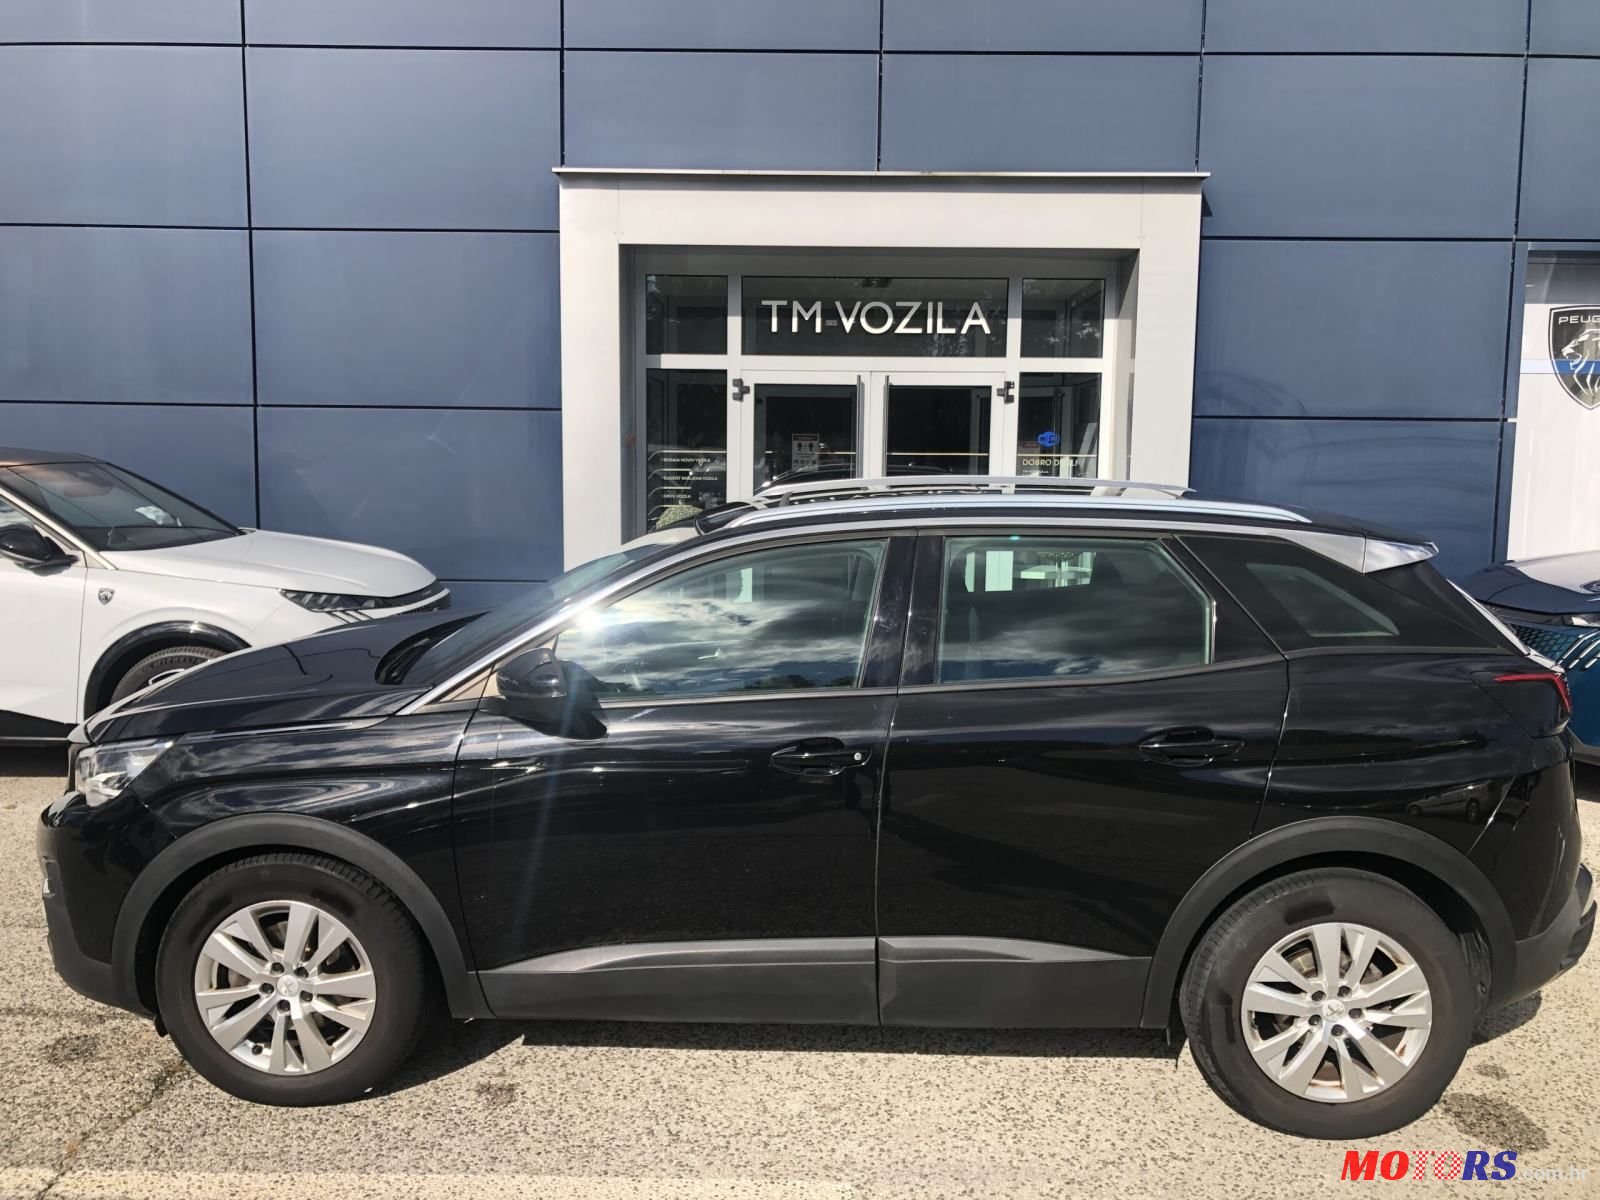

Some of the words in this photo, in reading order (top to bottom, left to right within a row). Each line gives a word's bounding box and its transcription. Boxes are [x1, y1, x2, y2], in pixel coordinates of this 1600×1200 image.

[834, 301, 991, 335] VOZILA
[1022, 458, 1052, 466] DOBRO
[1053, 459, 1078, 467] DLI
